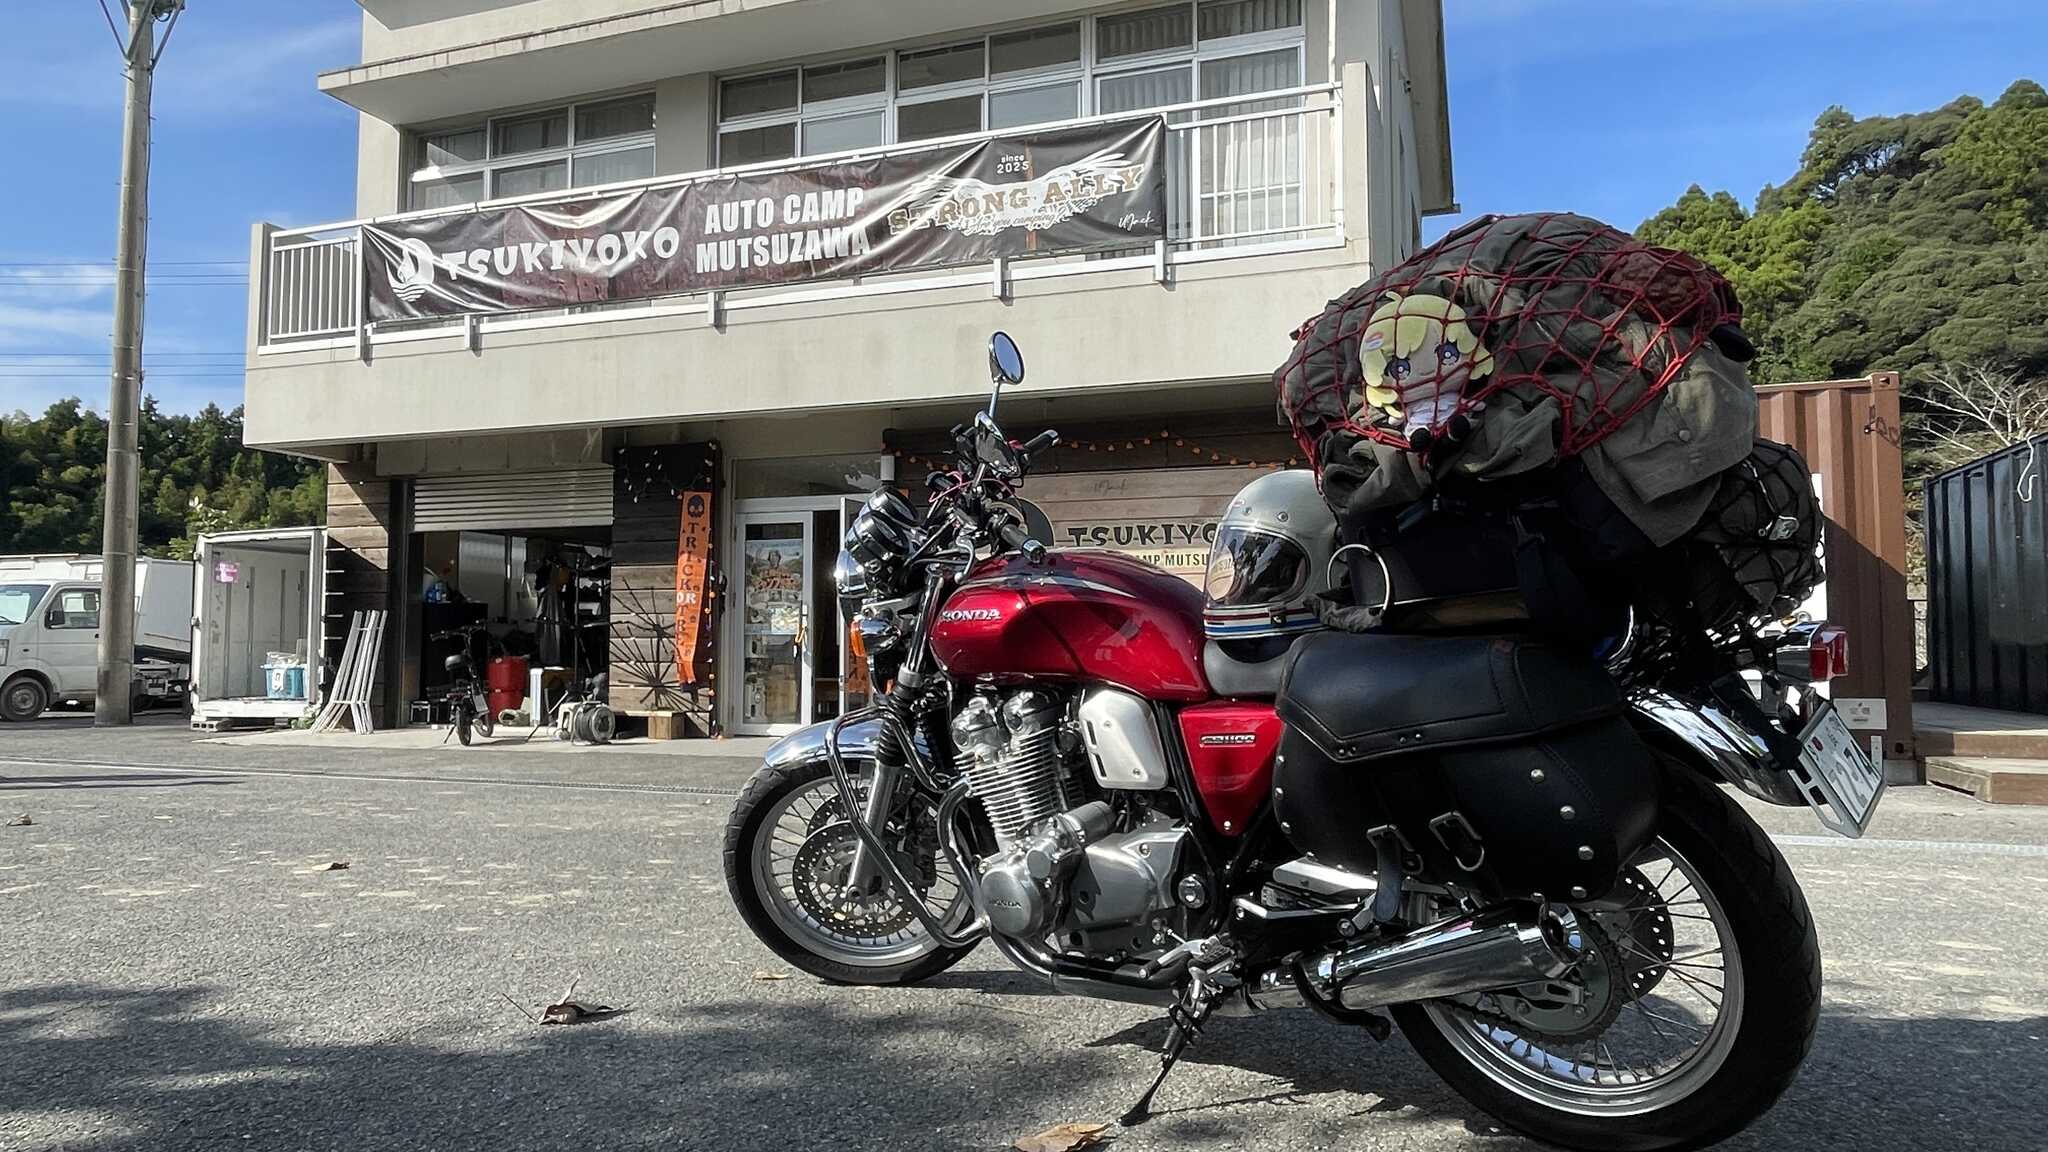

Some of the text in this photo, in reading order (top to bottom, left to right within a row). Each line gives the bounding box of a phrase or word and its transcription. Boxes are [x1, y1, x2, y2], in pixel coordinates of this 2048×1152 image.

[996, 161, 1029, 174] 2025
[1001, 154, 1025, 163] since
[1043, 166, 1143, 204] ALLY
[704, 187, 864, 235] AUTO CAMP
[442, 226, 680, 279] TSUKIYOKO
[696, 226, 870, 273] MUTSUZAWA
[680, 522, 699, 591] TRICK
[676, 592, 697, 606] OR
